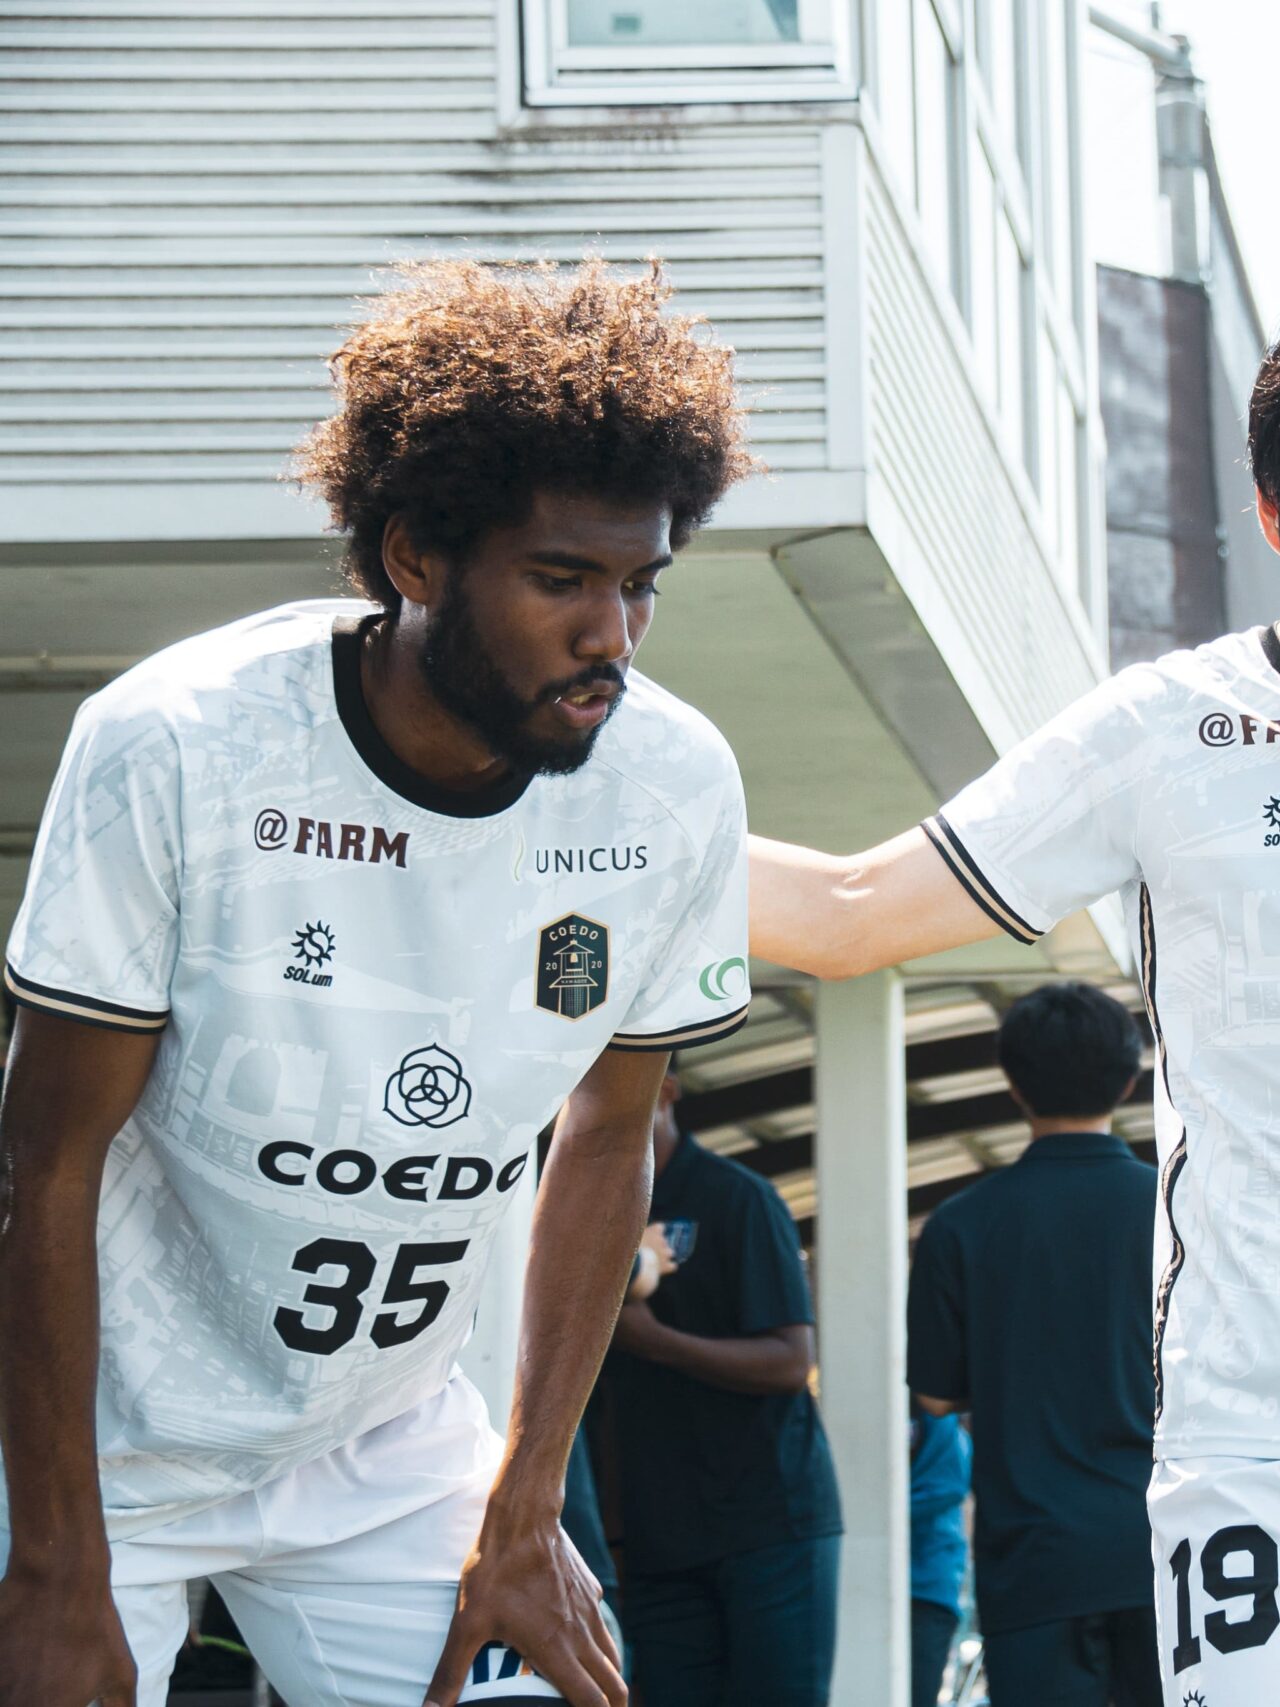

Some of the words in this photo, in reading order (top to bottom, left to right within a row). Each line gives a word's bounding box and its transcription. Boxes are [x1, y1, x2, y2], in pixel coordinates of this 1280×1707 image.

[254, 808, 411, 868] @FARM
[535, 845, 649, 874] UNICUS
[548, 924, 599, 941] COEDO
[283, 964, 334, 988] SOLum
[274, 1237, 471, 1356] 35
[1169, 1524, 1280, 1676] 19
